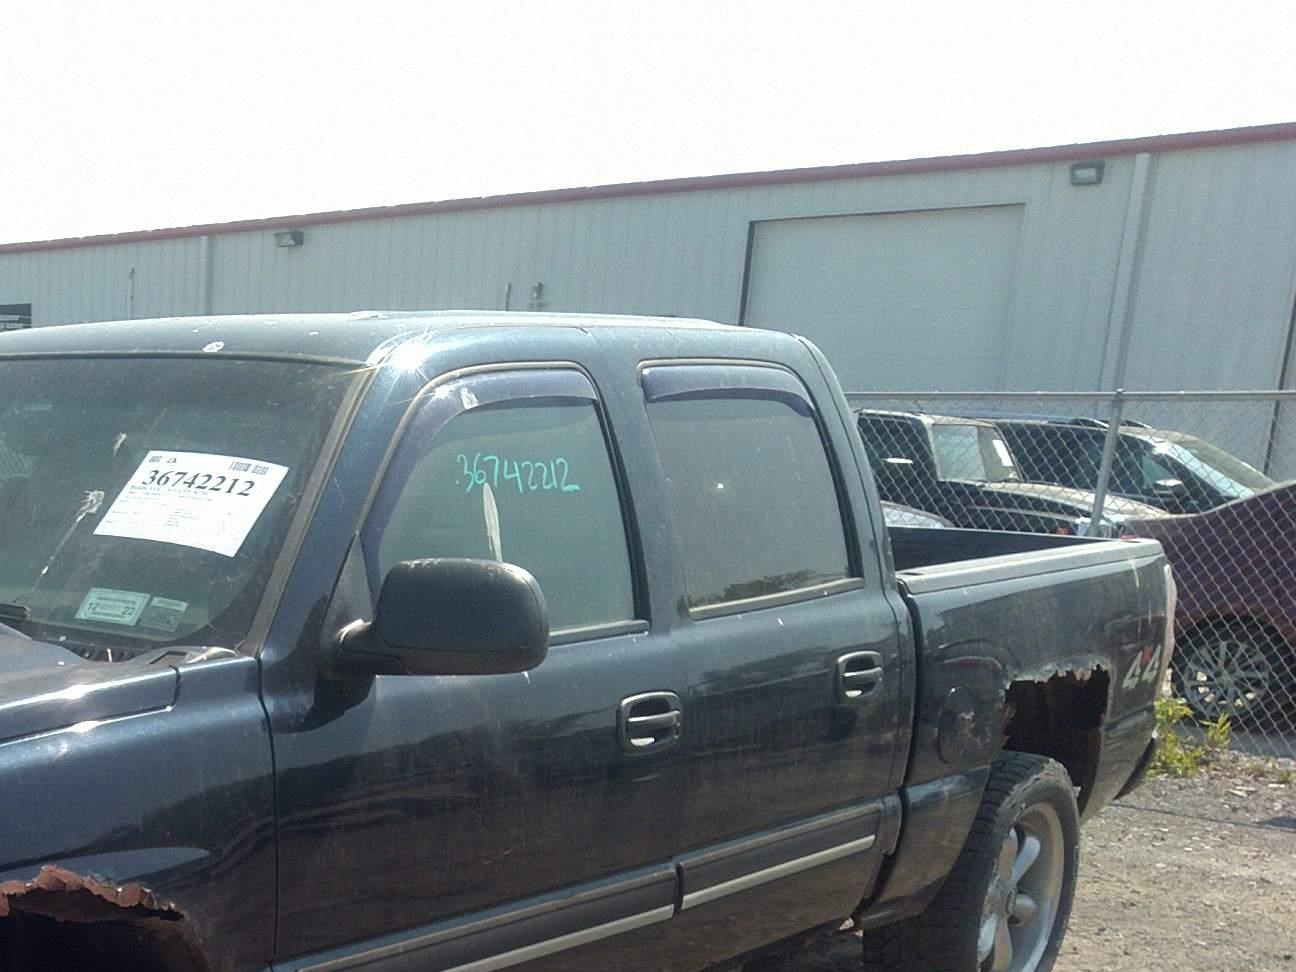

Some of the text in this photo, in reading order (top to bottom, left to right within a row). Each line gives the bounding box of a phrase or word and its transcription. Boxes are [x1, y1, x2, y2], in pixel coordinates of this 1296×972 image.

[141, 469, 256, 497] 36742212
[456, 452, 581, 494] 36742212
[121, 606, 136, 616] 22
